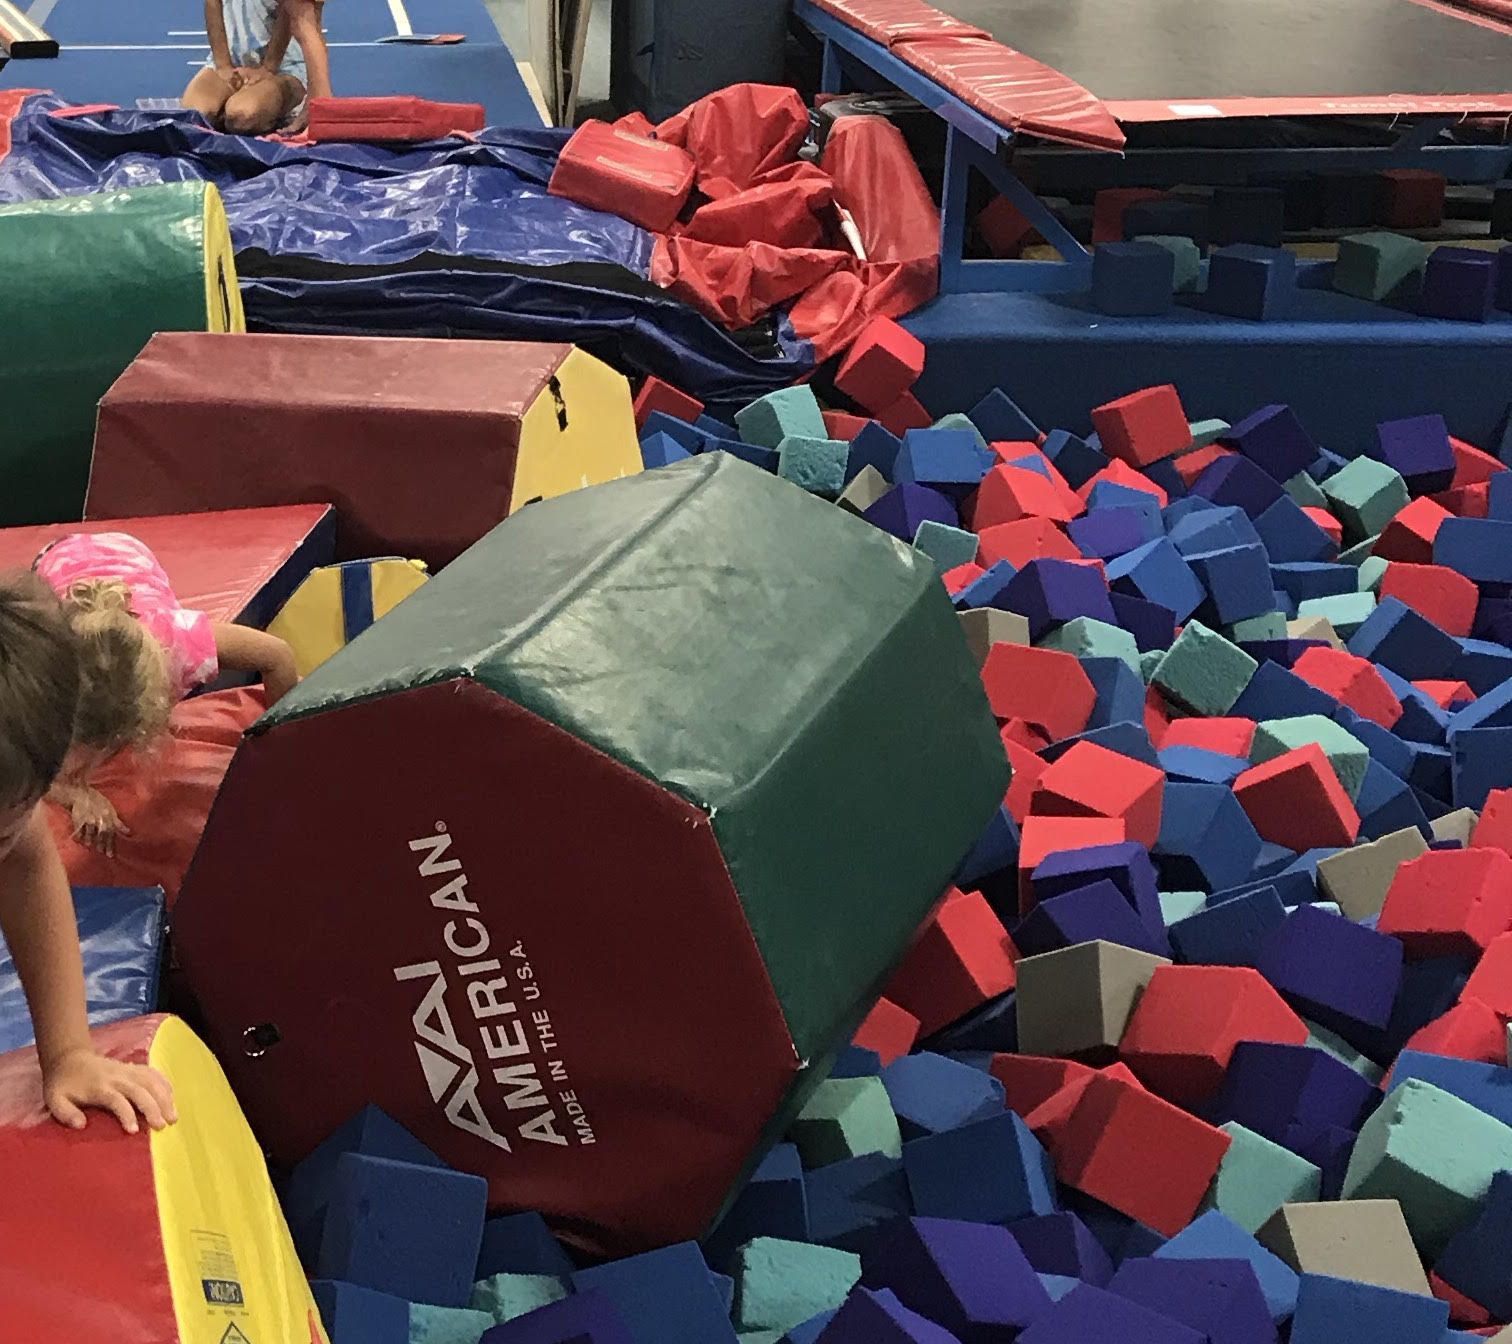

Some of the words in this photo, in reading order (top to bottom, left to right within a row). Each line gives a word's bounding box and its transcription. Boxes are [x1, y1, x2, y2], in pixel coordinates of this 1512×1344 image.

[509, 939, 542, 1001] U.S.A.
[532, 1009, 558, 1053] THE
[547, 1060, 569, 1082] IN
[558, 1089, 597, 1146] MADE
